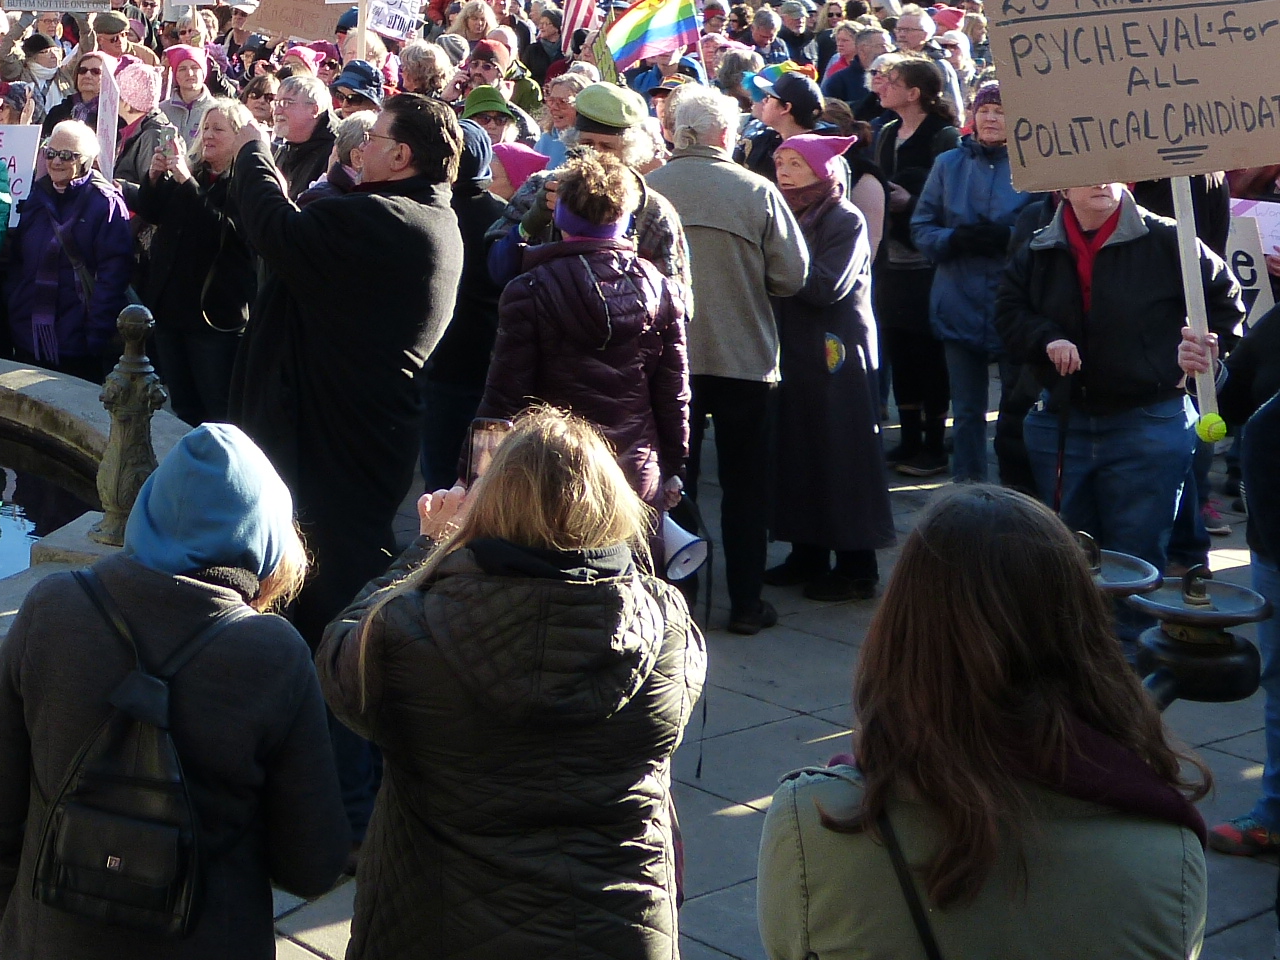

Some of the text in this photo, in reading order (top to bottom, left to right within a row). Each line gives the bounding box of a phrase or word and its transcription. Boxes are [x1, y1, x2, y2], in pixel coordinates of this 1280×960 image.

[7, 0, 24, 8] BUT
[37, 0, 53, 8] NOT
[54, 0, 70, 8] THE
[1127, 63, 1200, 96] ALL
[1014, 108, 1159, 168] POLITICAL
